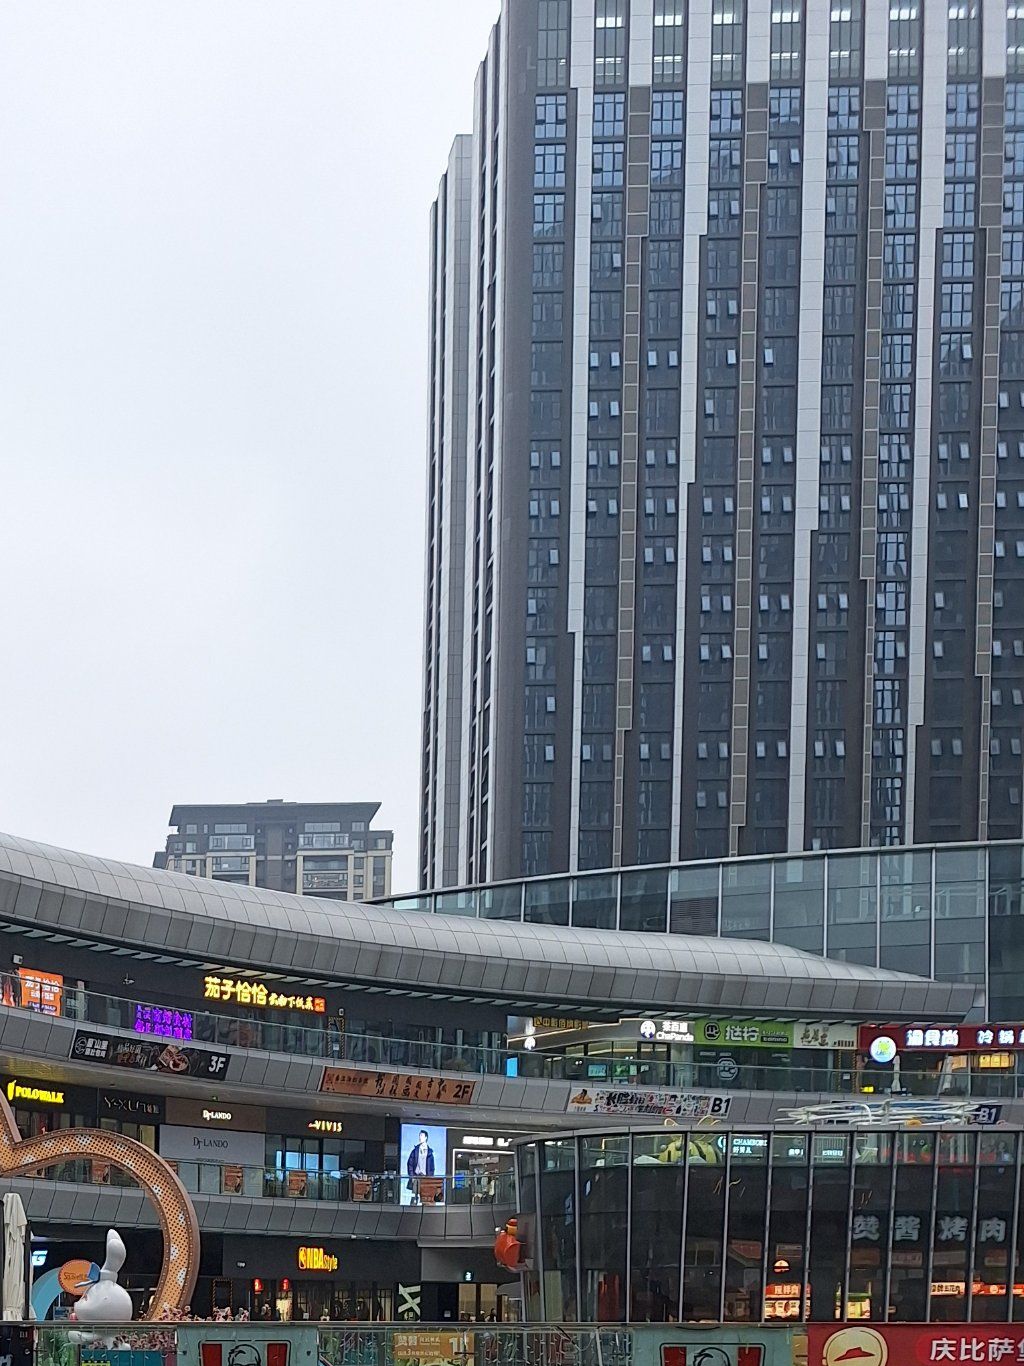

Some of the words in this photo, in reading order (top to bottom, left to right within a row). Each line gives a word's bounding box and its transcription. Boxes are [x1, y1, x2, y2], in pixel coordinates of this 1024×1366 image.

[656, 1031, 695, 1042] ChaPanda
[208, 1055, 226, 1073] 3F
[452, 1084, 471, 1099] 2F
[710, 1096, 732, 1115] B1
[306, 1247, 324, 1270] NBA
[929, 1337, 1024, 1362] 庆比萨
